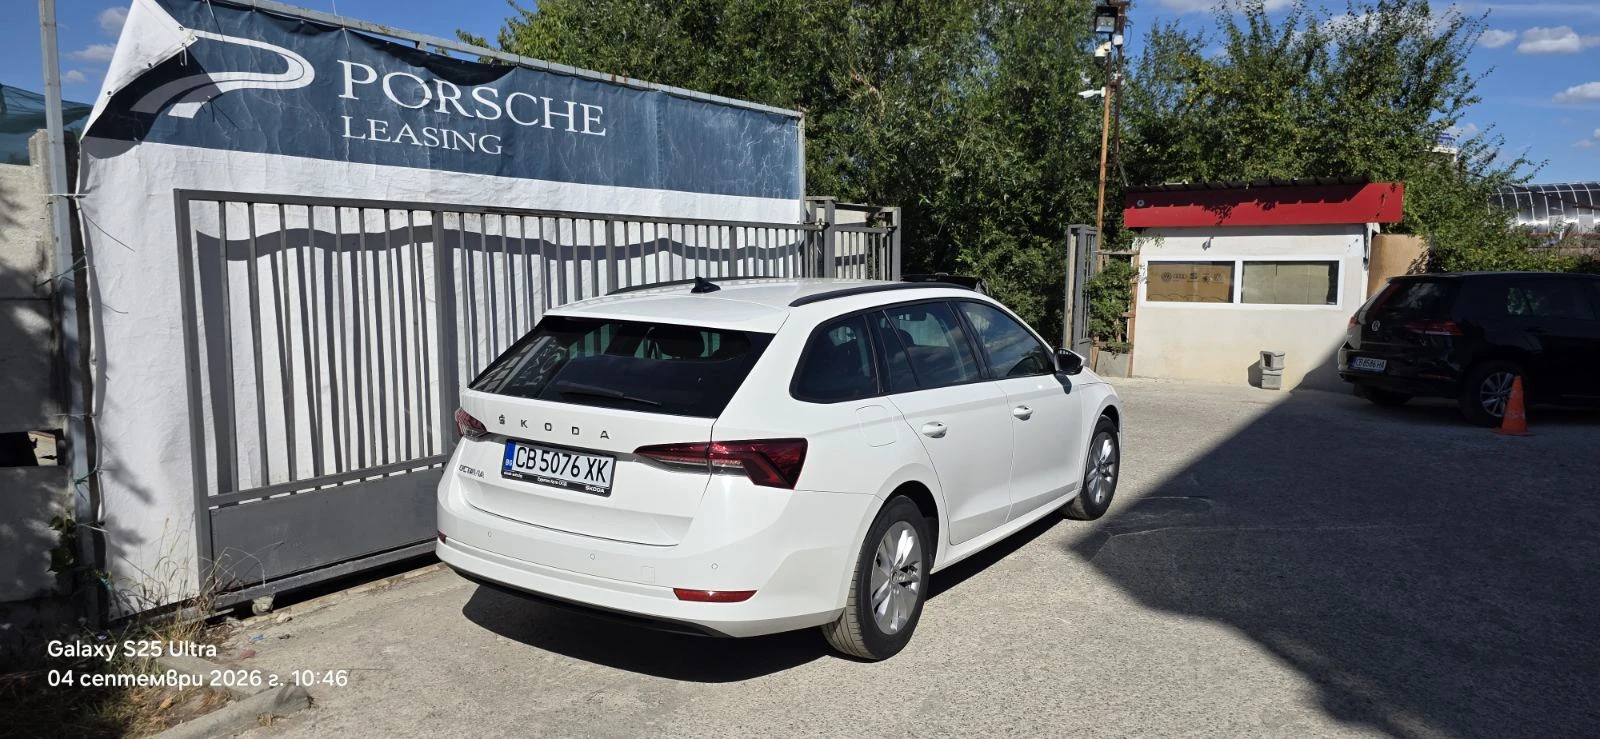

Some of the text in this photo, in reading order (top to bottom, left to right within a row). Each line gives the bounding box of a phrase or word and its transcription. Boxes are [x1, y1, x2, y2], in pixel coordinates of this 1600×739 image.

[337, 59, 607, 137] PORSCHE
[342, 115, 502, 155] LEASING
[458, 464, 485, 479] OCTAVIA
[505, 458, 513, 466] BG
[515, 446, 609, 483] CB 5076 XK
